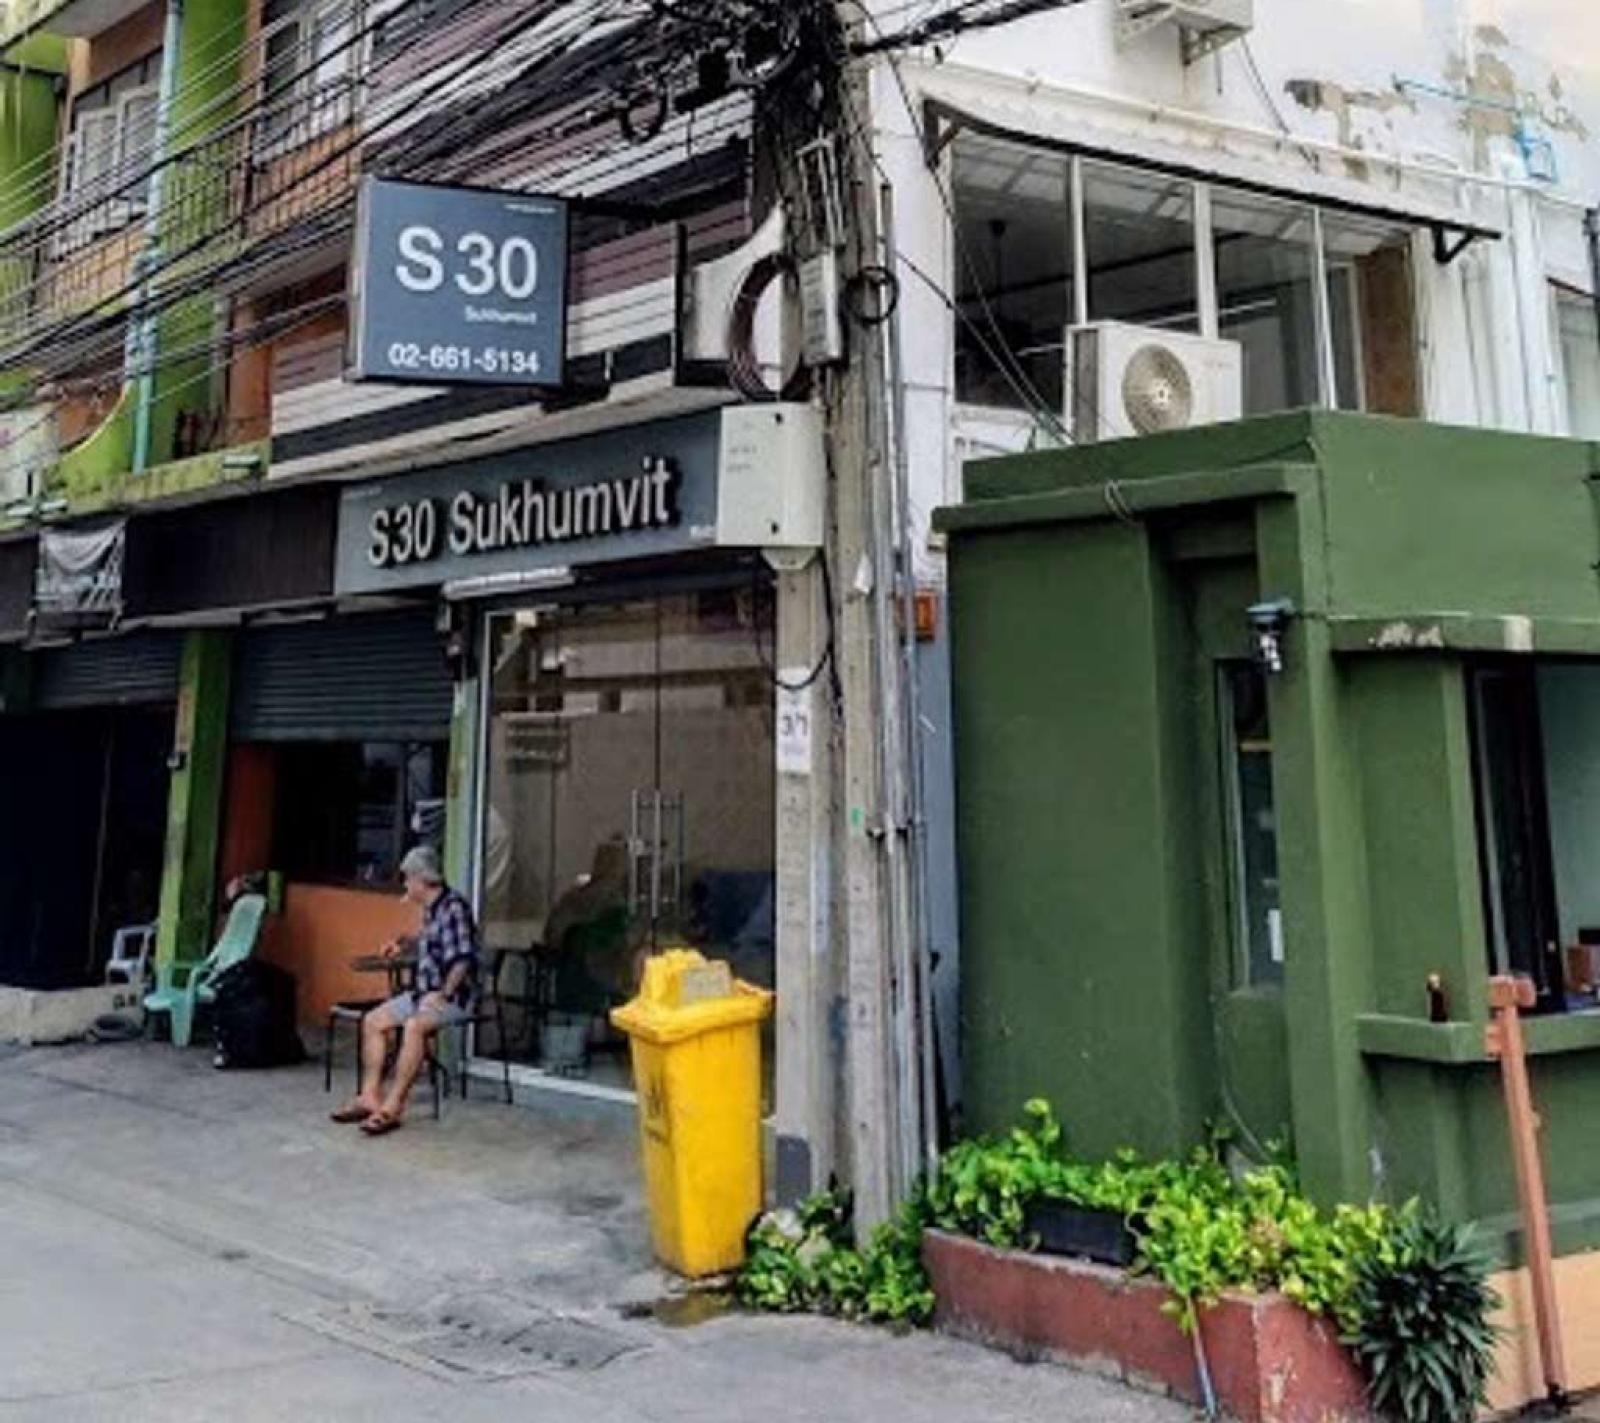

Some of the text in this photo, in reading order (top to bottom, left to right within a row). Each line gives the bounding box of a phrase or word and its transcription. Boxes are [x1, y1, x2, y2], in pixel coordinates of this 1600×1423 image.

[387, 343, 538, 373] 02-661-5134
[369, 457, 671, 567] S30 Sukhumvit
